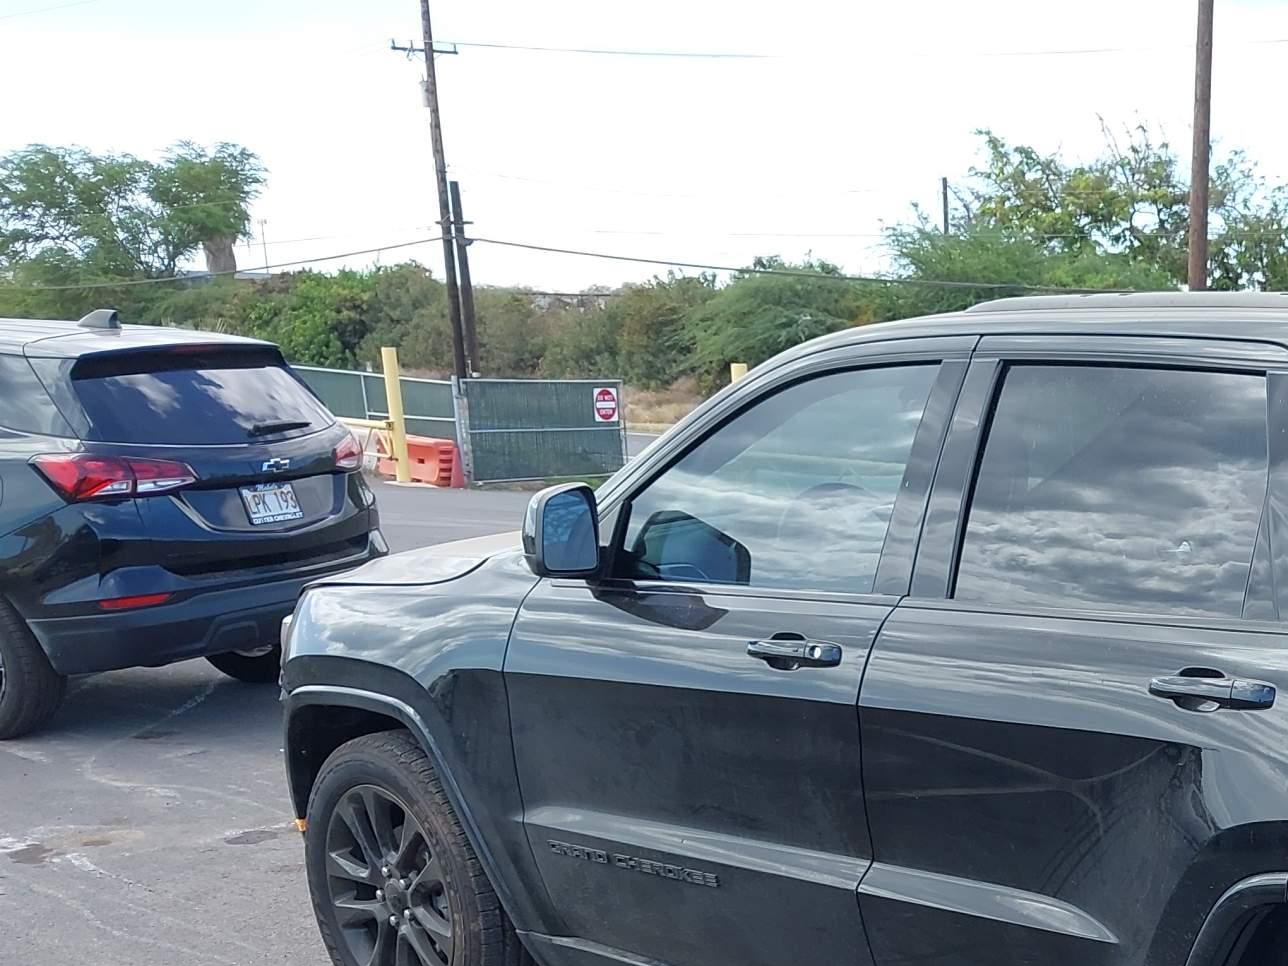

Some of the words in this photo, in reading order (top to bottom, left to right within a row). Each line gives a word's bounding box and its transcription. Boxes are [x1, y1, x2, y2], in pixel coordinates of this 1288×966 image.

[245, 493, 272, 514] LPK
[274, 490, 298, 511] 193
[547, 839, 609, 864] GRAND
[613, 853, 719, 888] CHEROKEE
